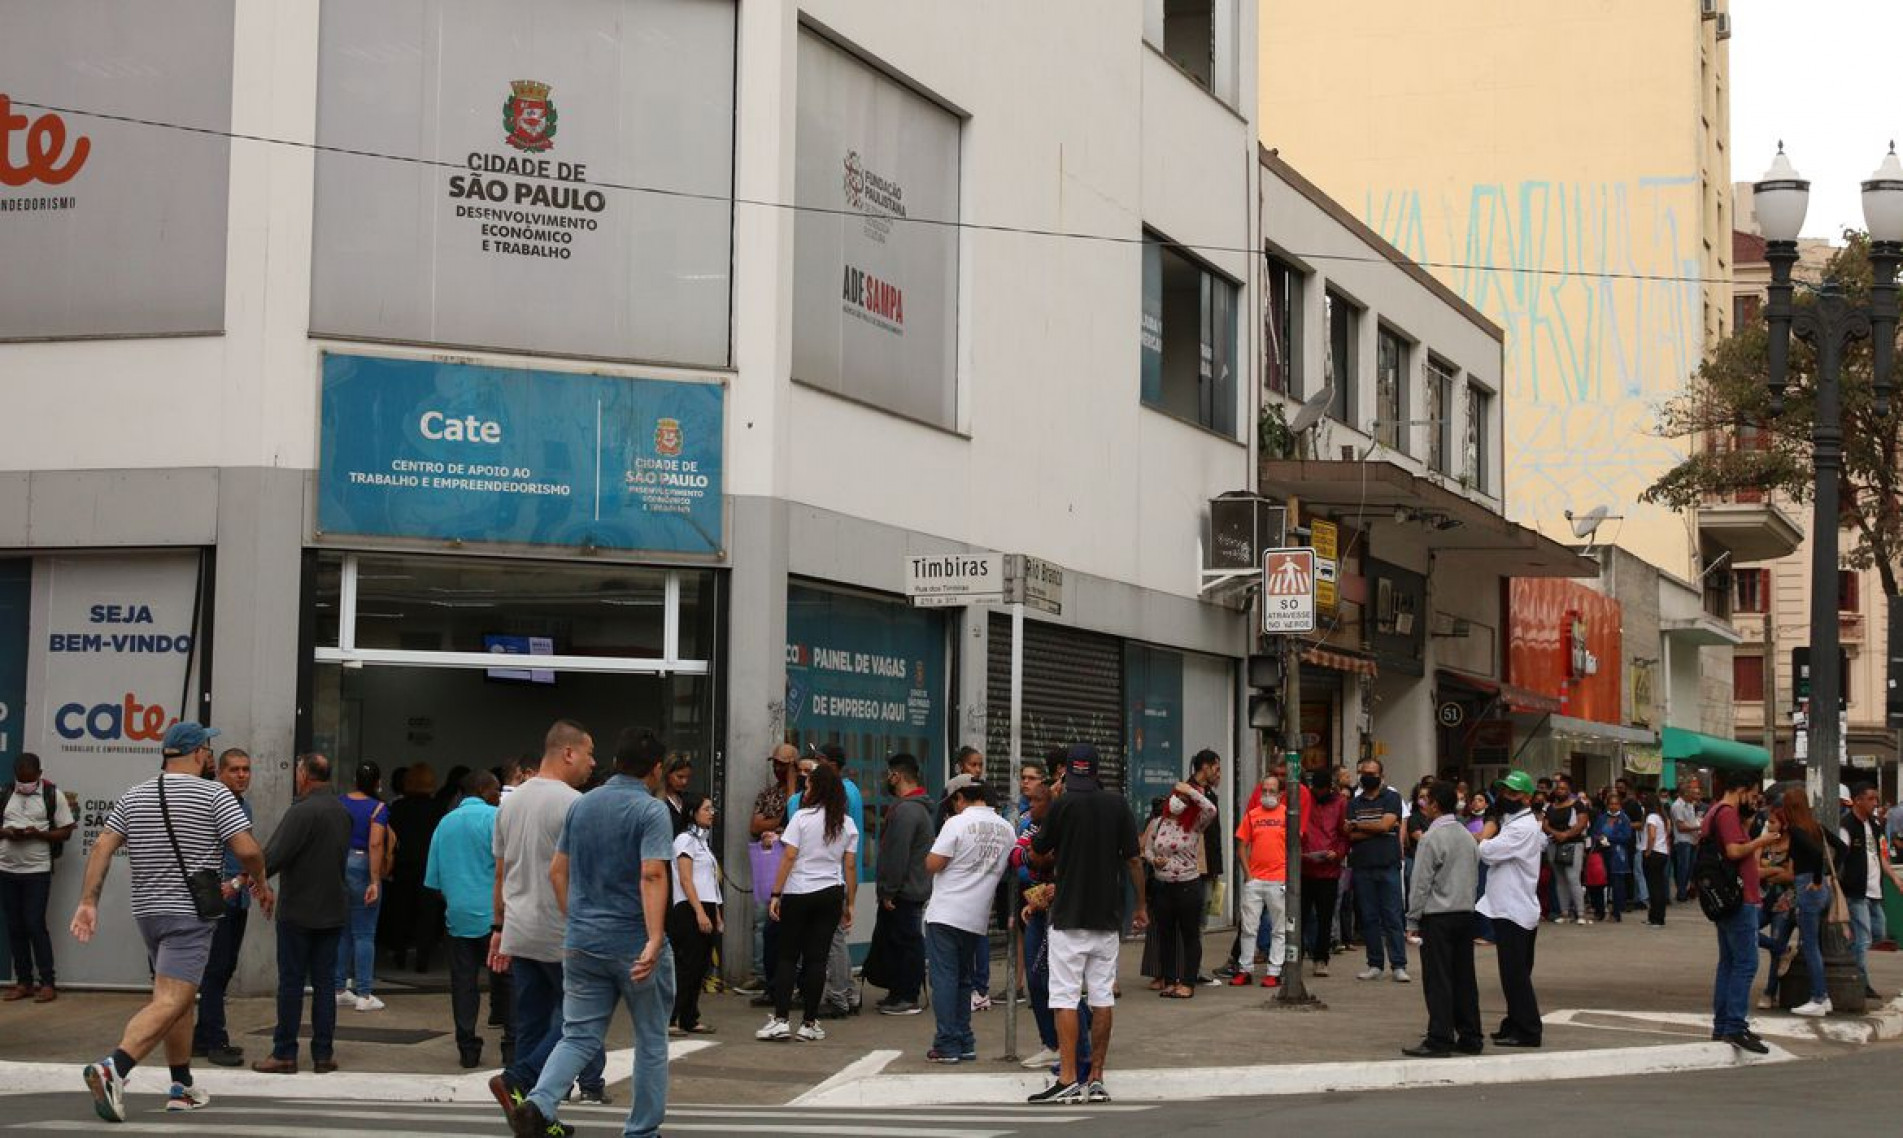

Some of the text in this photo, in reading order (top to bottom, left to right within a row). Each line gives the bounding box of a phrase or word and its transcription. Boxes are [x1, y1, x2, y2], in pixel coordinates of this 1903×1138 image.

[467, 152, 586, 182] CIDADE DE
[449, 172, 606, 213] SÃO PAULO
[456, 205, 598, 231] DESENVOLVIMENTO
[481, 223, 572, 244] ECONÔMICO
[482, 239, 571, 260] E TRABALHO
[420, 411, 501, 443] Cate
[391, 459, 531, 479] CENTRO DE APOIO AO
[635, 458, 699, 472] CIDADE DE
[349, 471, 571, 496] TRABALHO E EMPREENDEDORISMO
[660, 472, 709, 488] PAULO
[912, 556, 988, 578] Timbiras
[914, 585, 928, 593] Rua
[90, 604, 153, 624] SEJA
[1268, 611, 1311, 619] ATRAVESSE
[1268, 620, 1311, 628] NO VERDE
[49, 634, 193, 654] BEM-VINDO
[813, 646, 907, 679] PAINEL DE VAGAS
[55, 692, 180, 741] cate
[812, 695, 828, 715] DE
[830, 696, 879, 720] EMPREGO
[881, 701, 905, 722] AQUI
[1444, 708, 1457, 720] 51
